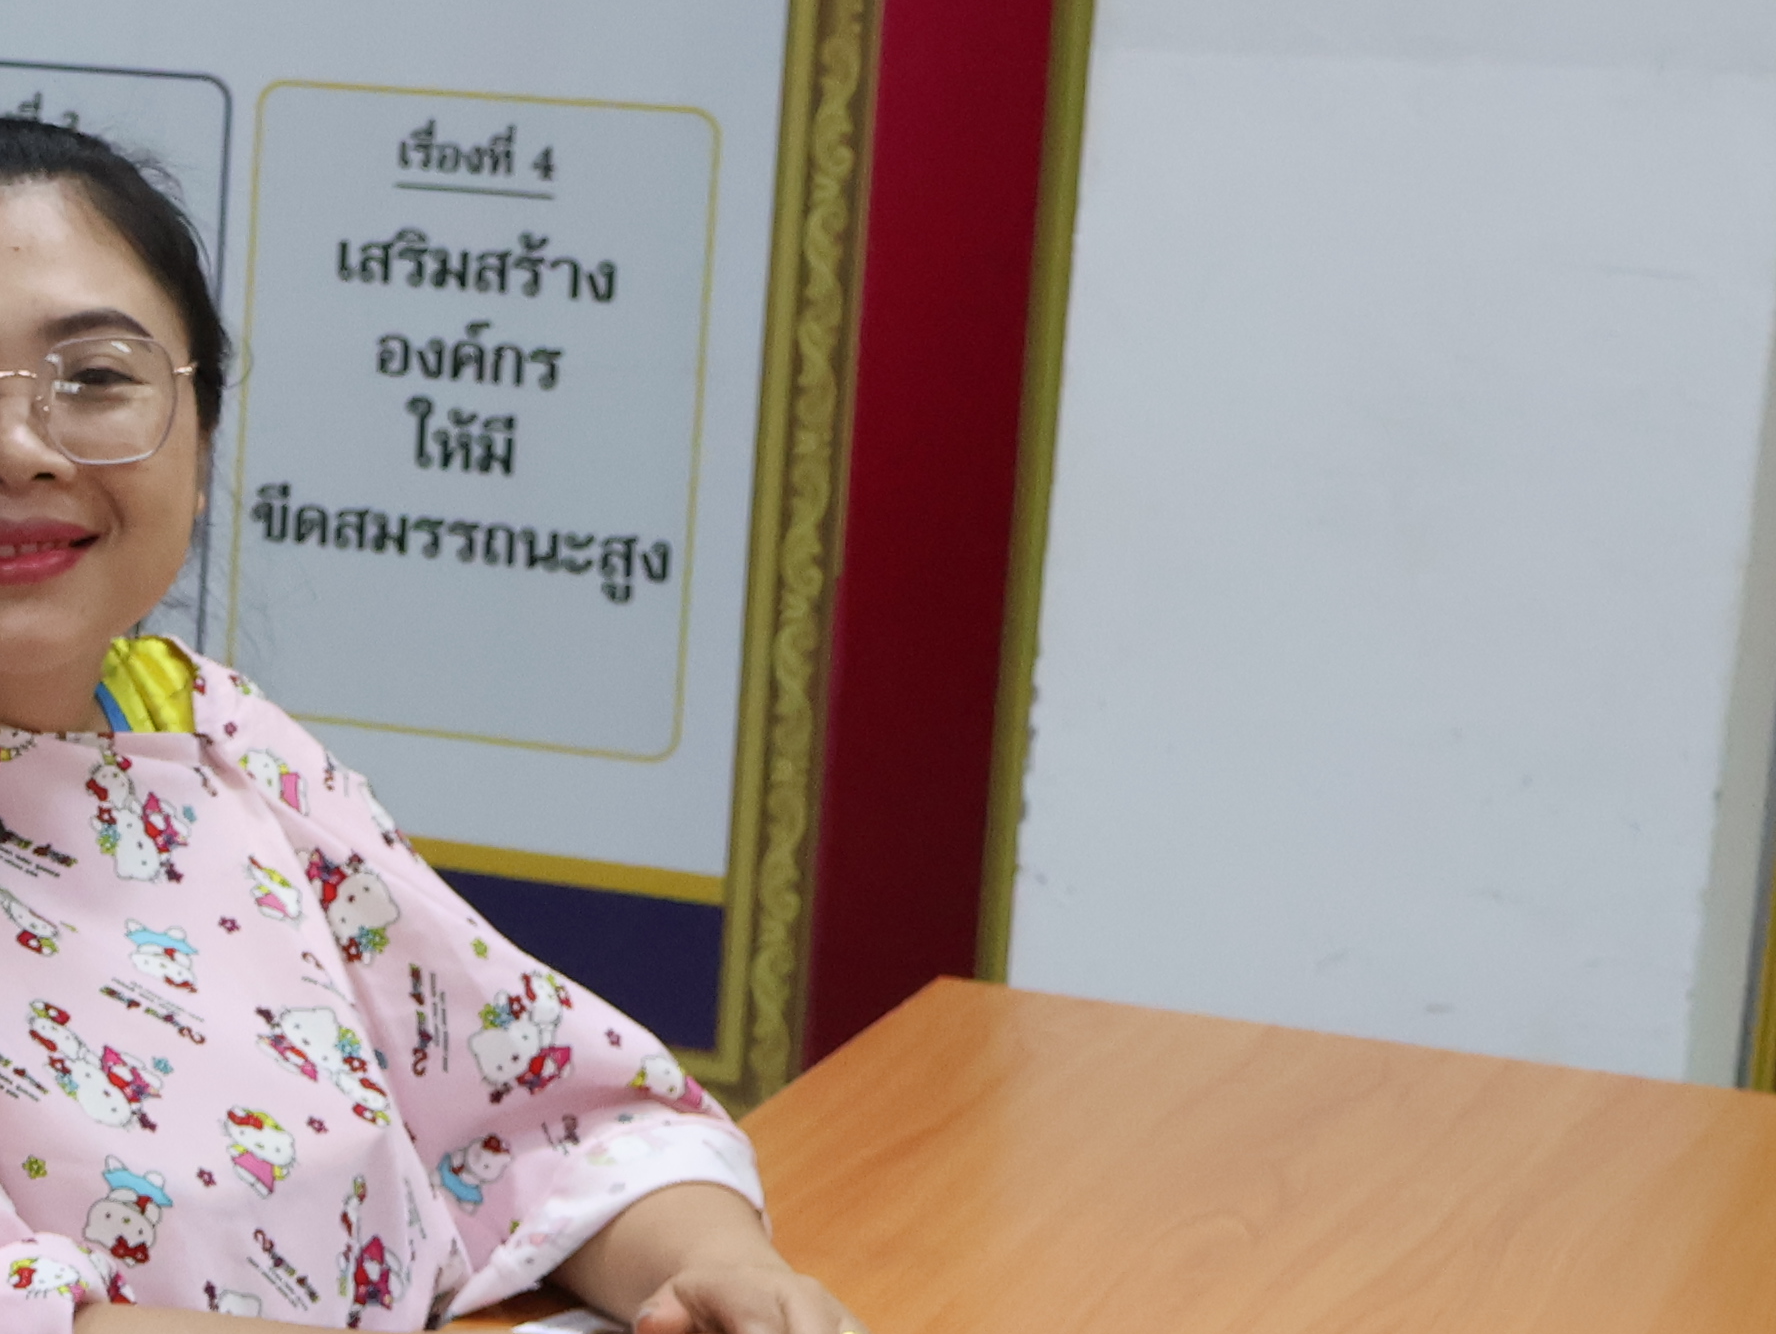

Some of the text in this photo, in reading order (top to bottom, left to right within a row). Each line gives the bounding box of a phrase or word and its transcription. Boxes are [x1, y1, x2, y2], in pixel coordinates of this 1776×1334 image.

[398, 118, 555, 182] เรื่องที่ 4
[337, 227, 618, 304] เสริมสร้าง
[375, 320, 565, 391] องค์กร
[405, 395, 516, 477] ให้มี
[250, 481, 672, 605] ขีดสมรรถนะสูง
